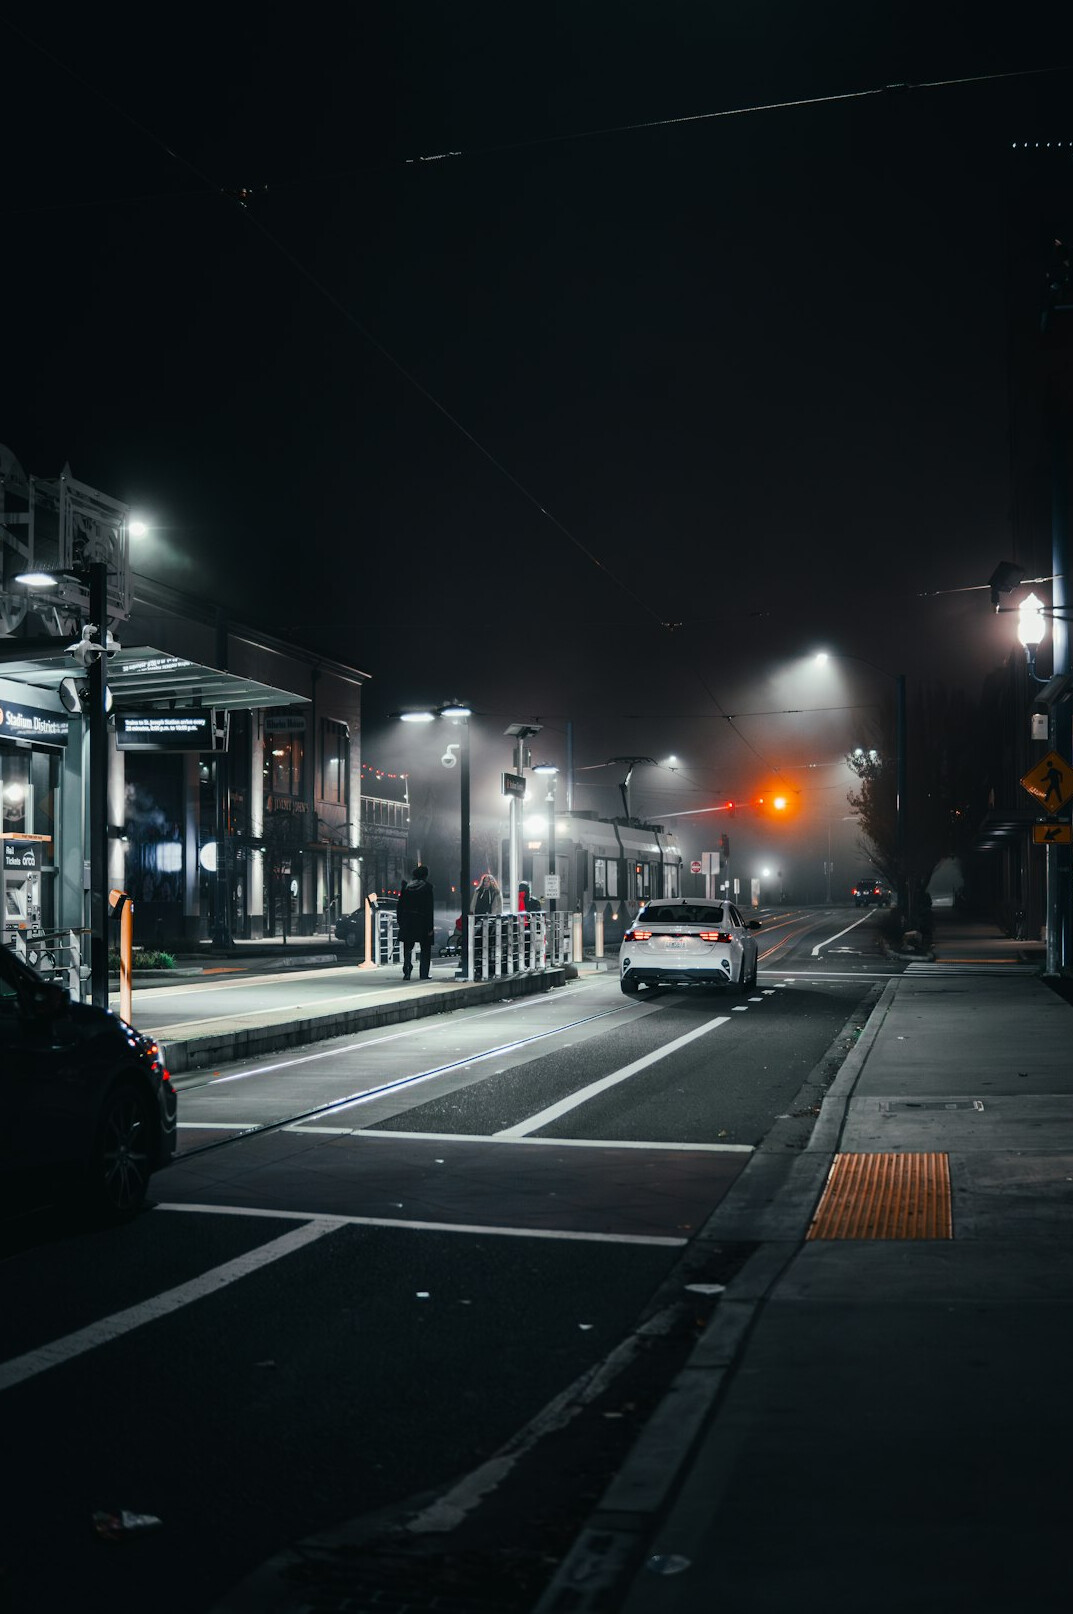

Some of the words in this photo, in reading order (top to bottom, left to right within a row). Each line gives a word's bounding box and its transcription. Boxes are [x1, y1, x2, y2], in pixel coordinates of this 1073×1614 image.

[5, 710, 33, 729] Stadium
[33, 716, 57, 735] District
[150, 719, 164, 727] Joseph
[193, 719, 206, 727] every
[6, 846, 15, 855] Rail
[6, 857, 22, 866] Tickets
